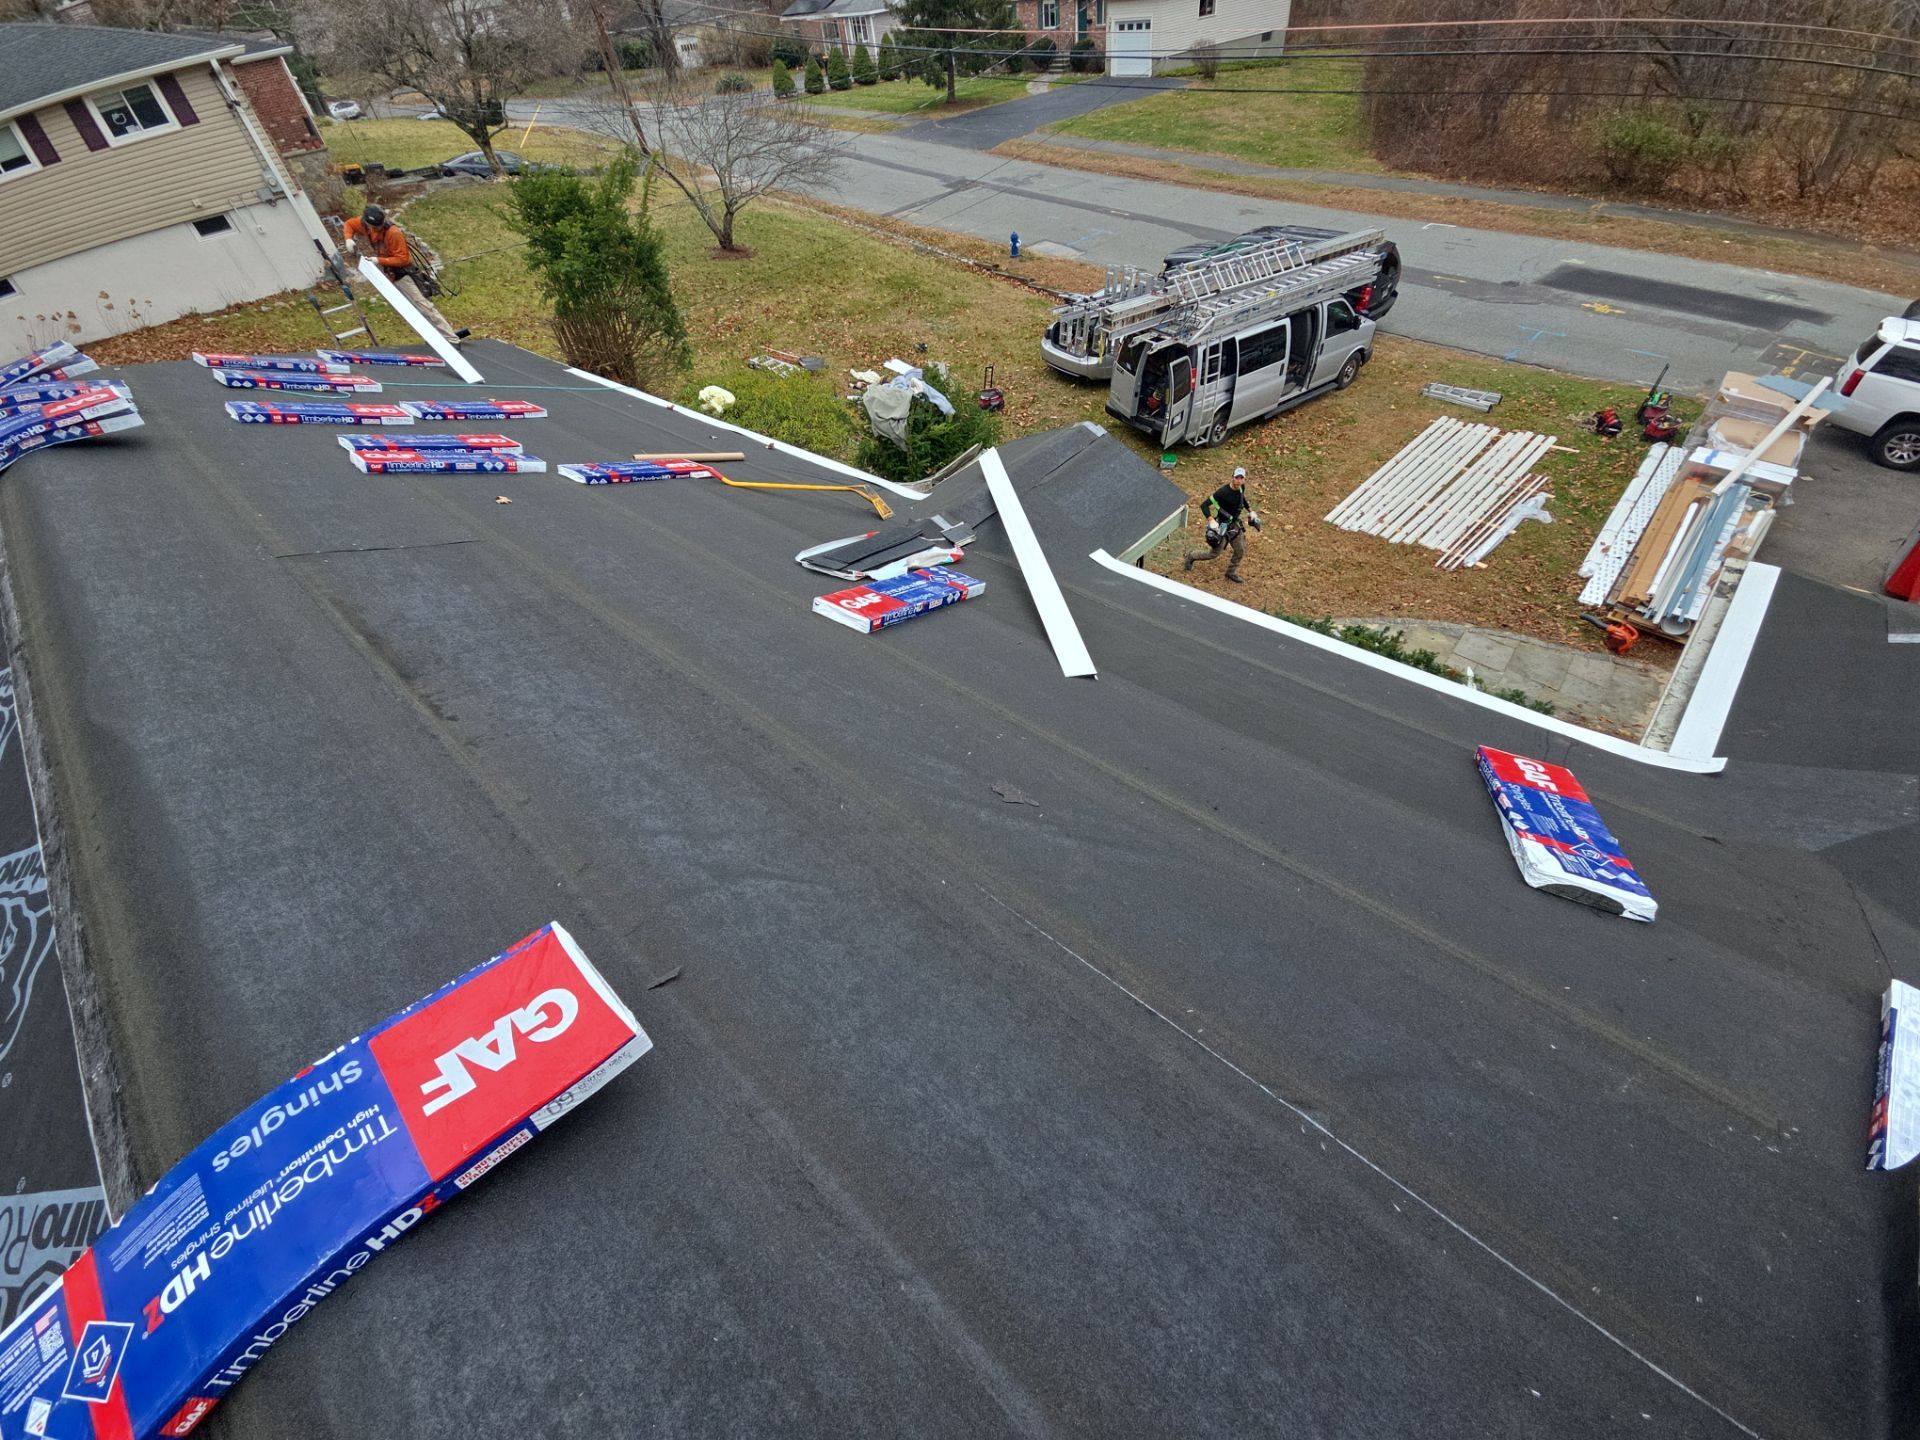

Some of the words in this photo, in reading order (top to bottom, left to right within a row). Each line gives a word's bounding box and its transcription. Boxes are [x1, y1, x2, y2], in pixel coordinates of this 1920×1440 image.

[300, 415, 342, 423] Timberline
[386, 461, 431, 469] Timberline
[839, 592, 882, 609] GAF
[1513, 757, 1559, 793] GAF
[420, 988, 580, 1118] GAF
[212, 1059, 363, 1173] Shingles
[347, 1103, 380, 1130] High
[280, 1127, 346, 1178] Definition
[458, 1172, 472, 1182] DO
[474, 1156, 492, 1171] NOT
[496, 1132, 526, 1154] TRIPLE
[462, 1164, 491, 1186] STACK
[493, 1136, 529, 1163] PALLETS
[210, 1114, 398, 1260] Timberline
[171, 1222, 221, 1270] Shingles
[203, 1251, 370, 1389] Timberline
[175, 1401, 208, 1433] GAF
